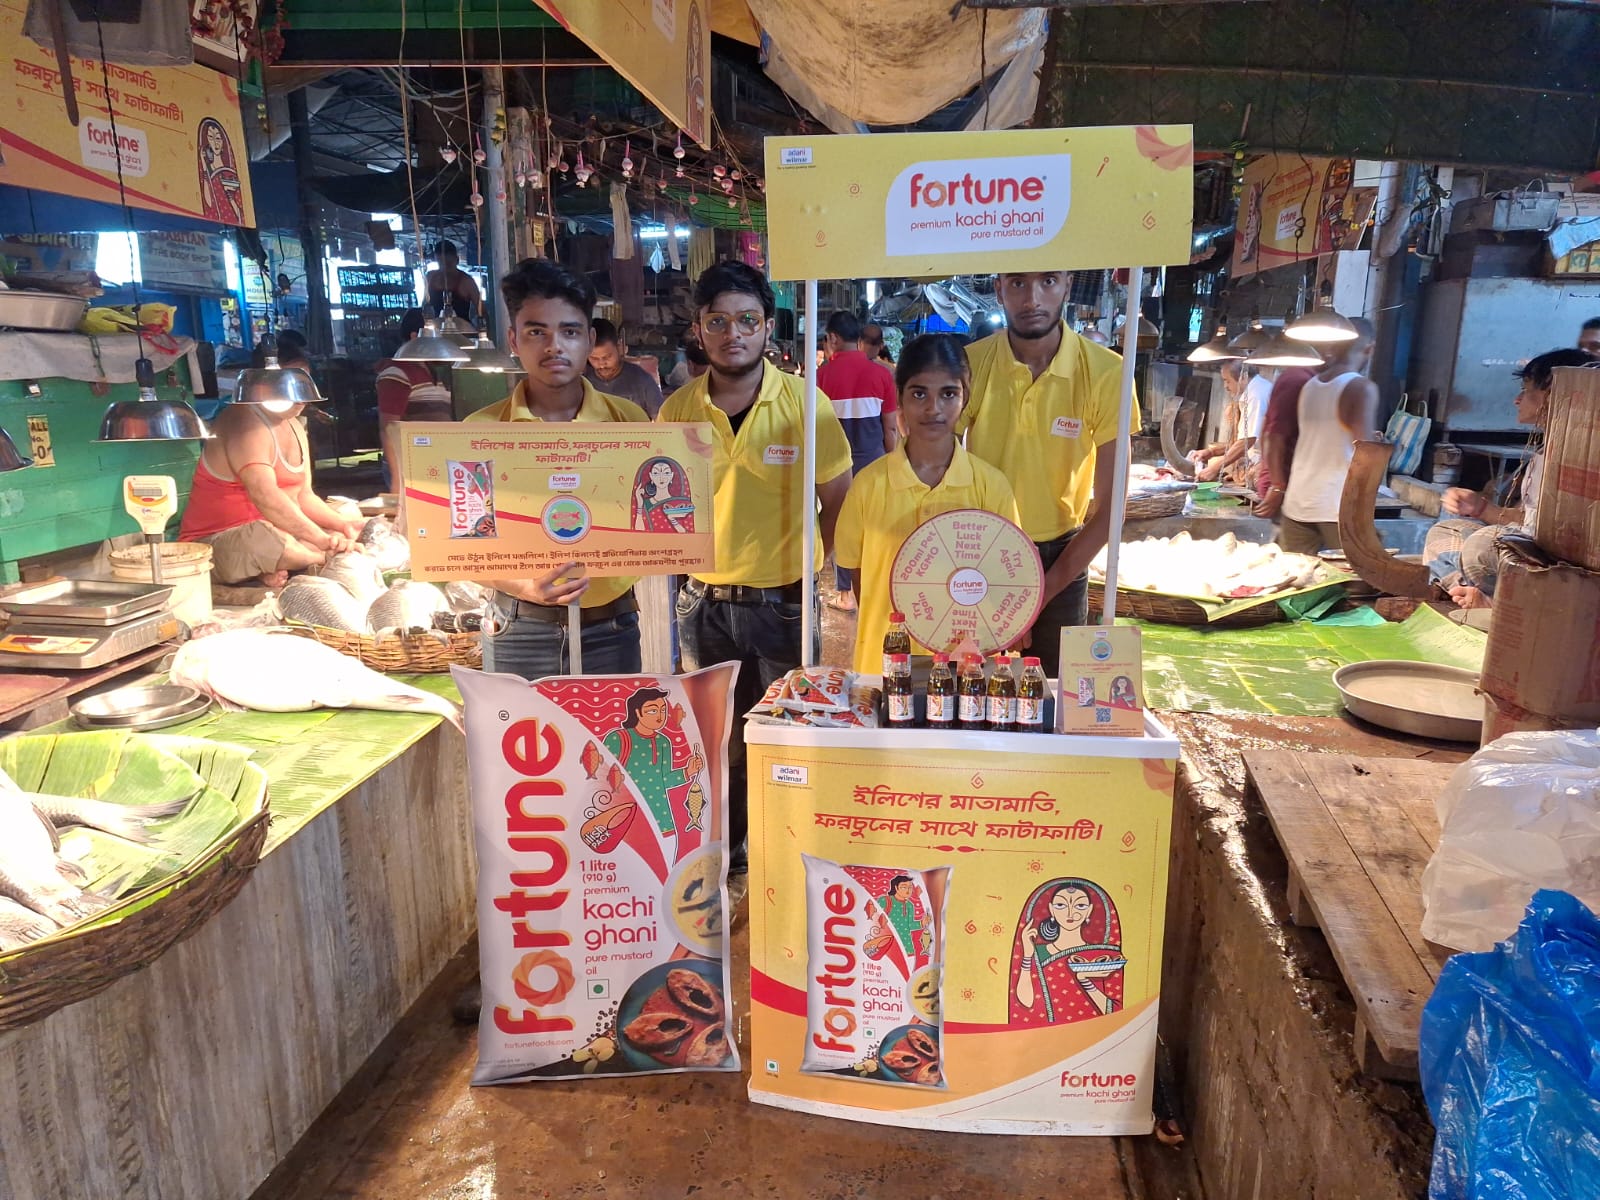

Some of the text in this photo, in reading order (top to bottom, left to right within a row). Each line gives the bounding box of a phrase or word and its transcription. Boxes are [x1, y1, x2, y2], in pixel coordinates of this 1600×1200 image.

[124, 92, 184, 124] ফাটাফাটি।
[910, 173, 1044, 208] fortune
[911, 208, 1044, 231] premium kachi ghani
[971, 227, 1044, 240] pure mustard oil
[471, 438, 515, 450] ইলিশের
[573, 441, 621, 453] ফরচুনের
[624, 440, 651, 449] সাথে
[453, 468, 468, 529] fortune
[952, 521, 988, 532] Better
[956, 532, 981, 541] Luck
[955, 541, 981, 550] Next
[916, 546, 939, 577] KGMO
[955, 550, 981, 560] Time
[1012, 550, 1023, 569] Try
[999, 549, 1016, 579] Again
[912, 602, 922, 620] Try
[918, 591, 934, 621] Again
[951, 609, 977, 619] Time
[991, 591, 1015, 622] KGMO
[951, 619, 977, 628] Next
[780, 767, 800, 775] adani
[853, 784, 1060, 816] ইলিশের মাতামাতি,
[815, 813, 1103, 841] ফরচুনের সাথে ফাটাফাটি।
[579, 860, 616, 871] 1 litre
[494, 717, 575, 1034] fortune
[582, 872, 617, 883] (910 g)
[584, 886, 630, 896] premium
[583, 896, 654, 920] kachi
[584, 921, 657, 951] ghani
[585, 950, 653, 964] pure mustard
[586, 967, 597, 975] oil
[813, 883, 857, 1053] fortune
[862, 984, 901, 998] kachi
[863, 998, 903, 1012] ghani
[1061, 1070, 1136, 1087] fortune
[1086, 1089, 1110, 1097] kachi
[1112, 1088, 1136, 1098] ghani
